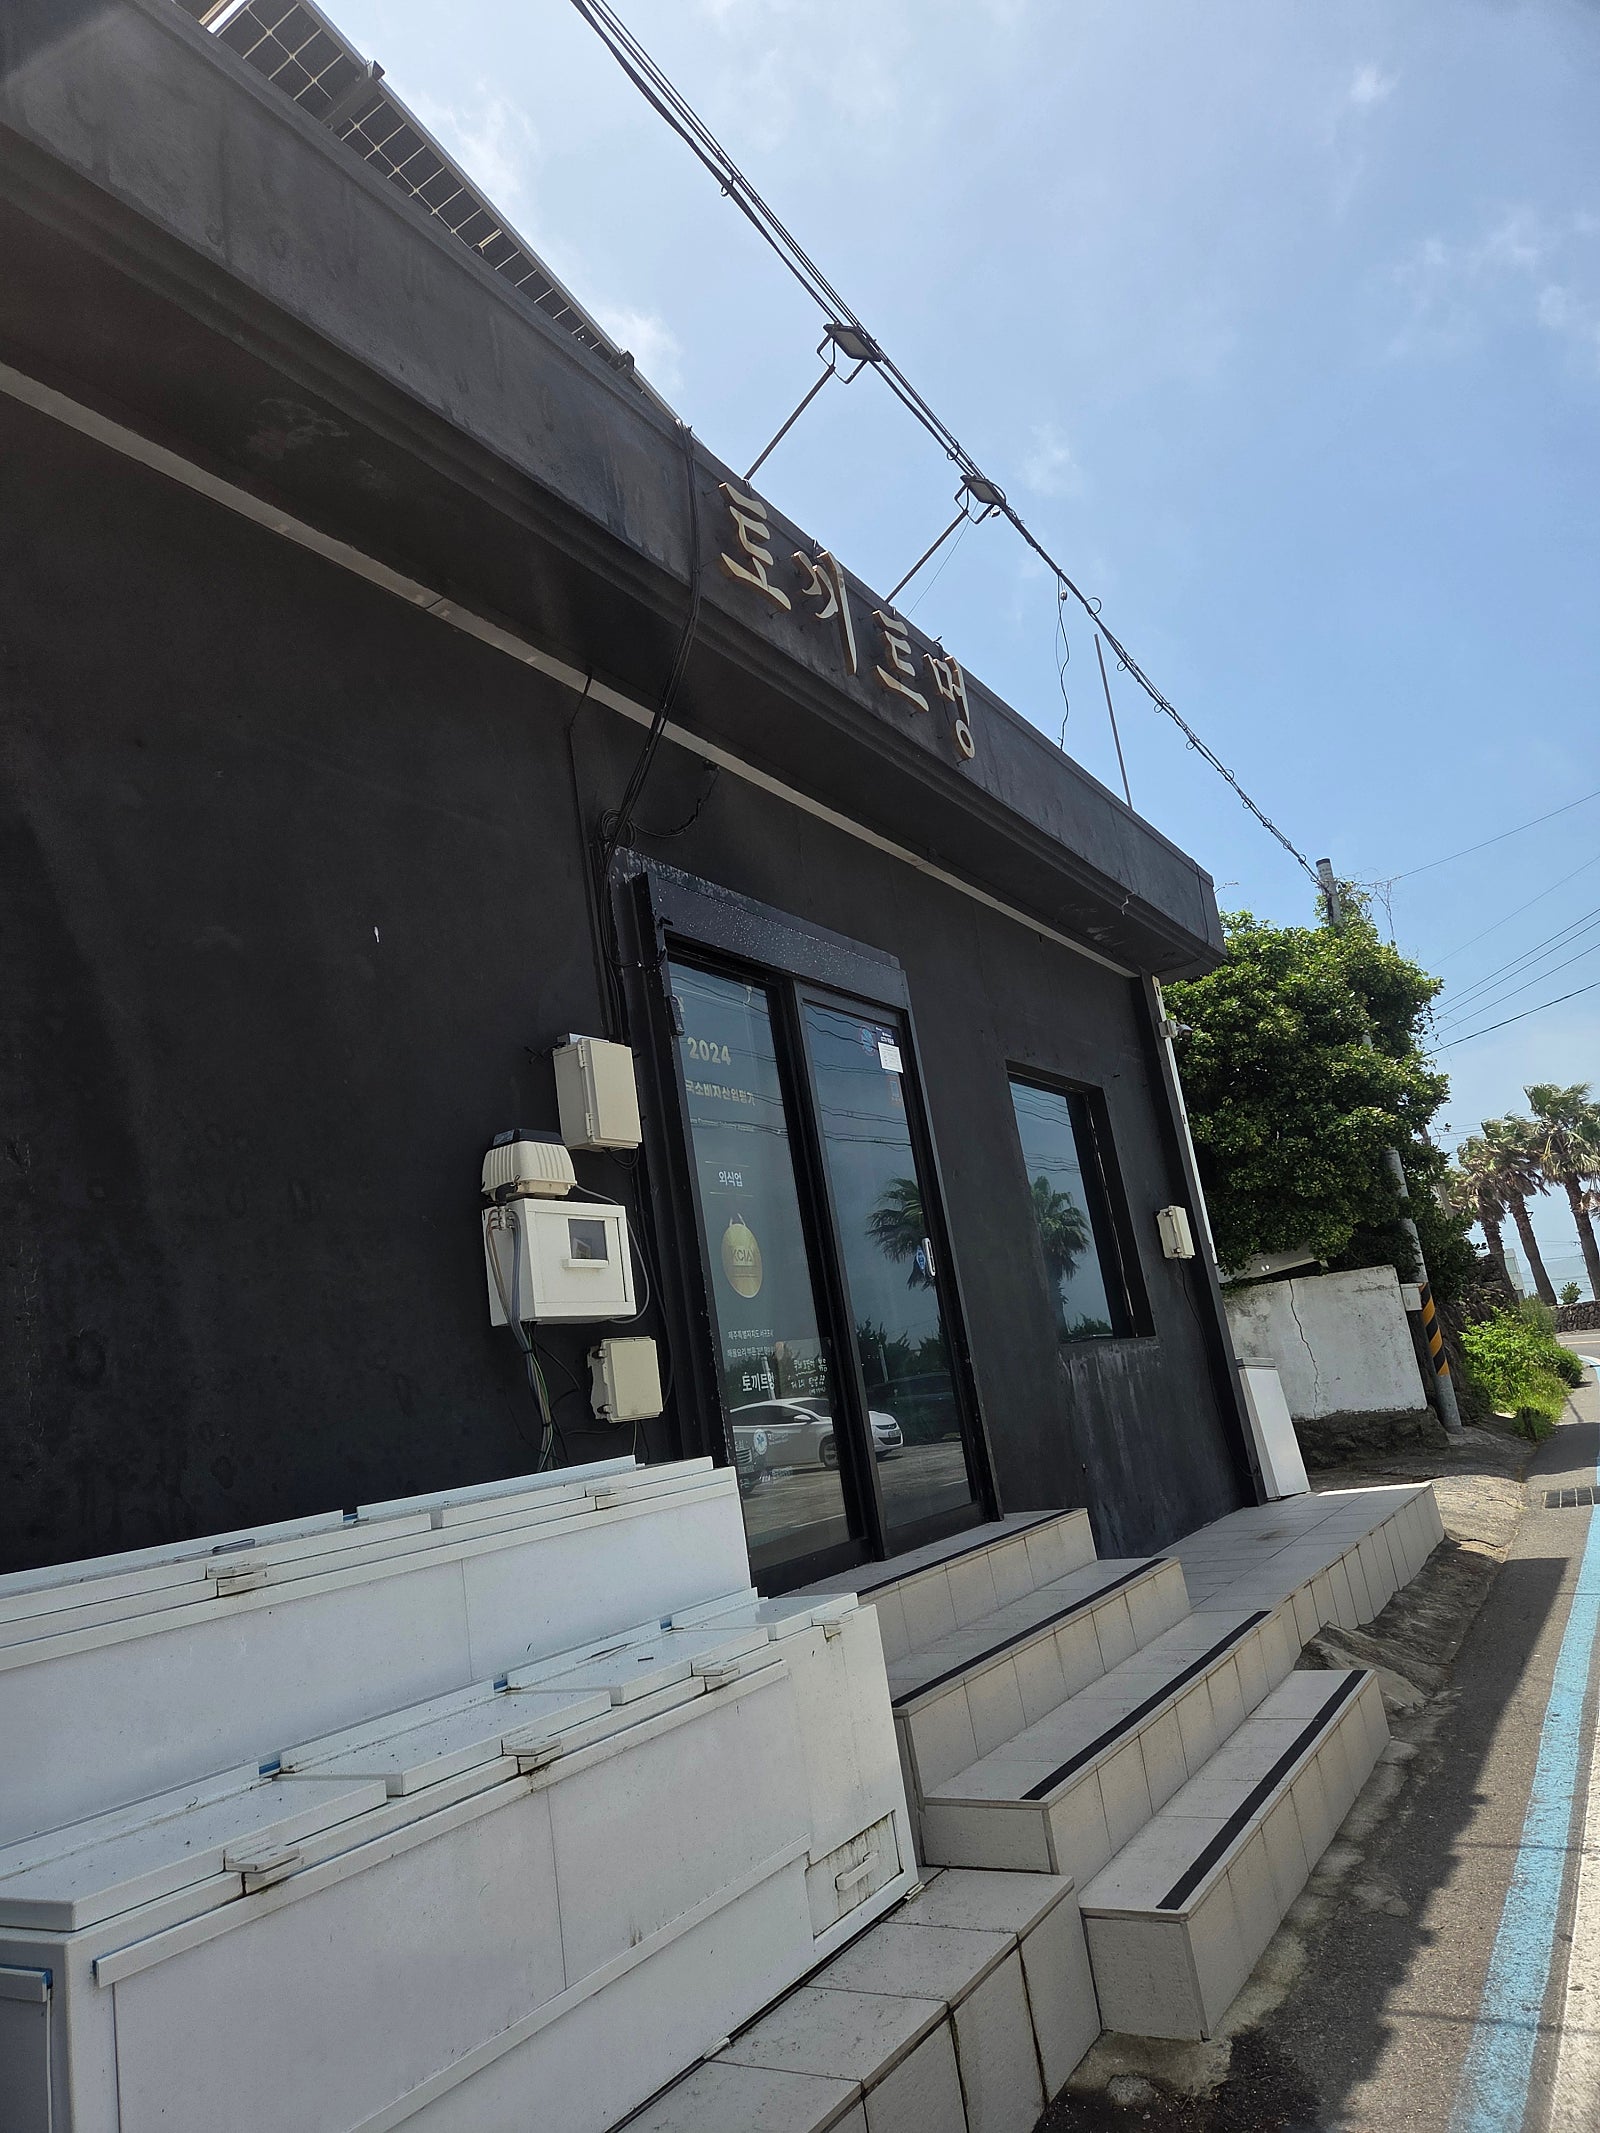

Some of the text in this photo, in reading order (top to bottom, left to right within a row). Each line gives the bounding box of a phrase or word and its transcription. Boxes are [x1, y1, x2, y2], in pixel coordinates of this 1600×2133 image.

[719, 482, 975, 759] 토끼트멍
[687, 1036, 731, 1065] 2024
[718, 1170, 743, 1187] 외식업
[742, 1371, 775, 1392] 토끼트멍
